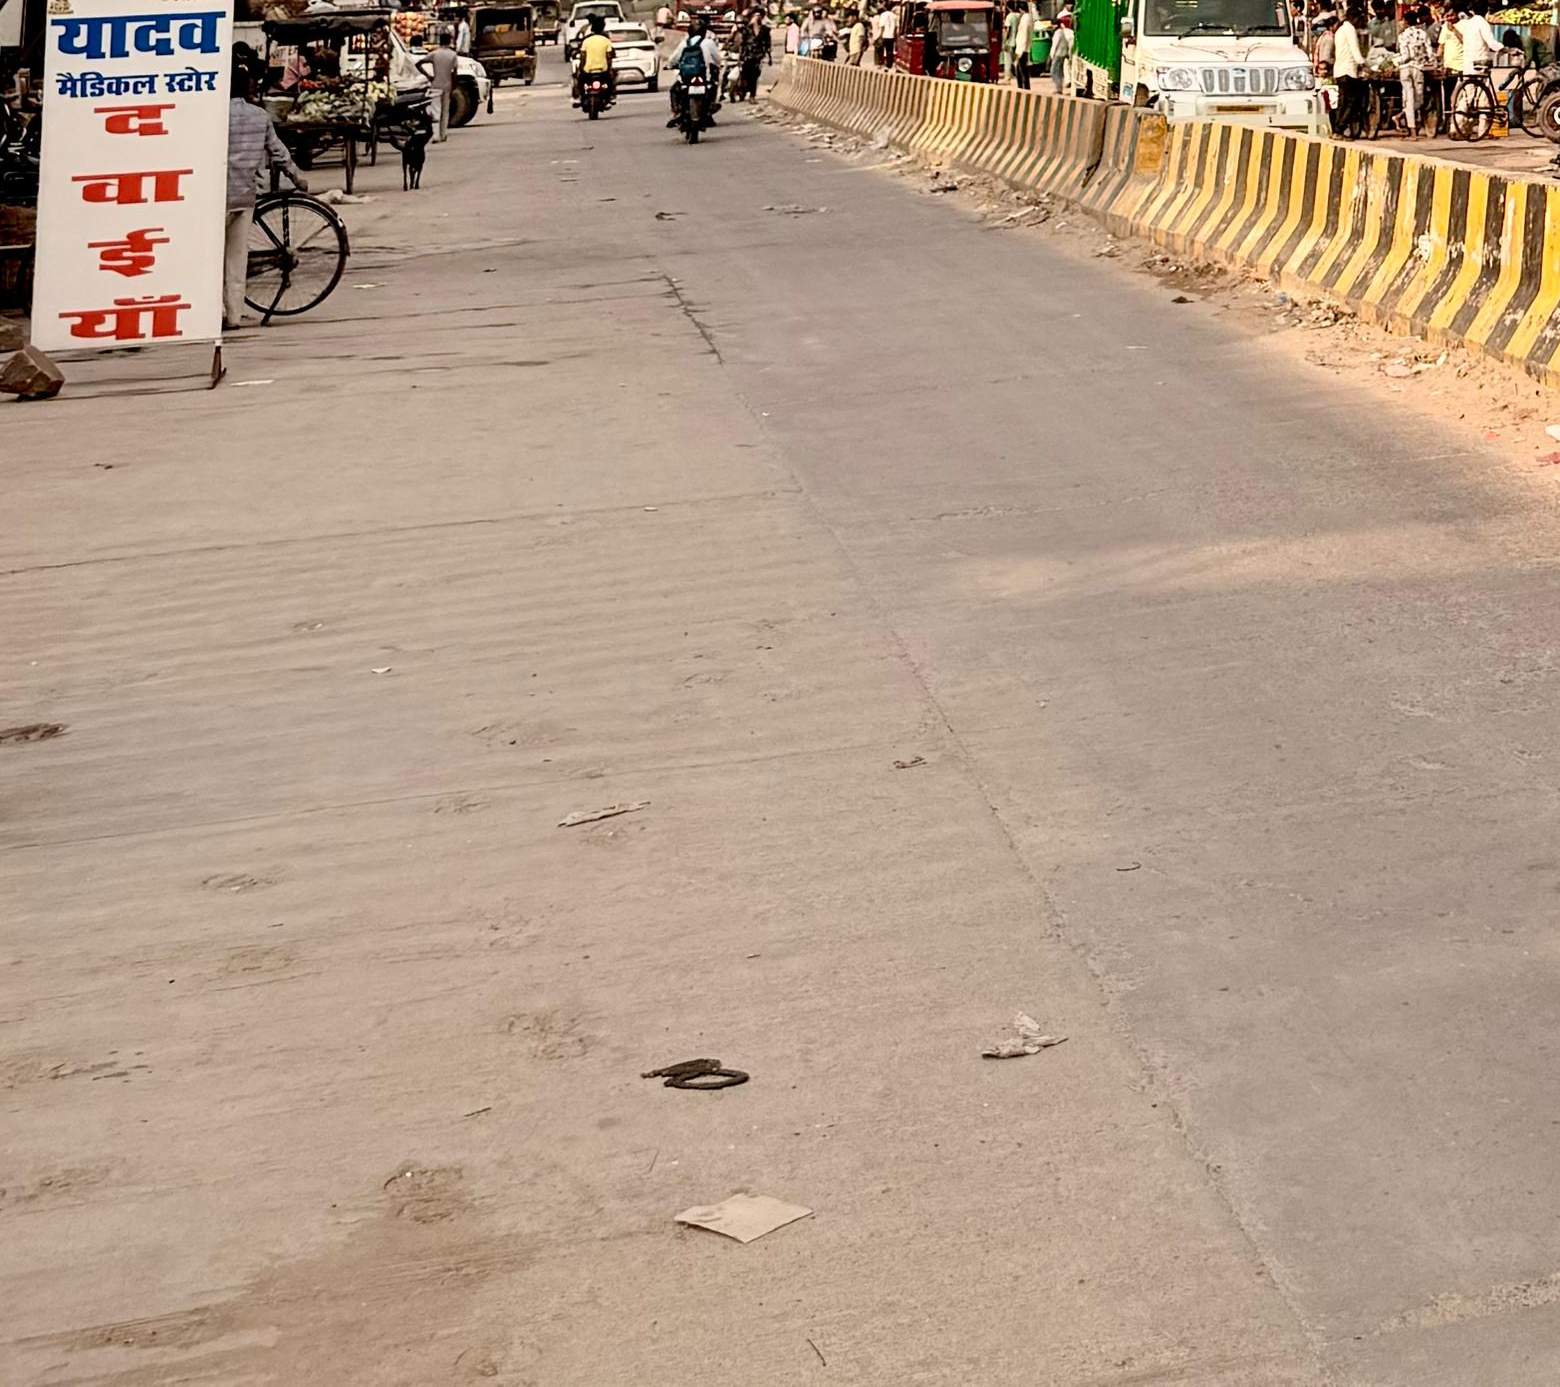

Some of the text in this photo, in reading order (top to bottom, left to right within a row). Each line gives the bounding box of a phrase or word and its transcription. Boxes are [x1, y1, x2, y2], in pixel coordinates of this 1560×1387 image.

[51, 10, 227, 60] यादव
[56, 66, 220, 98] मैडिकल स्टोर
